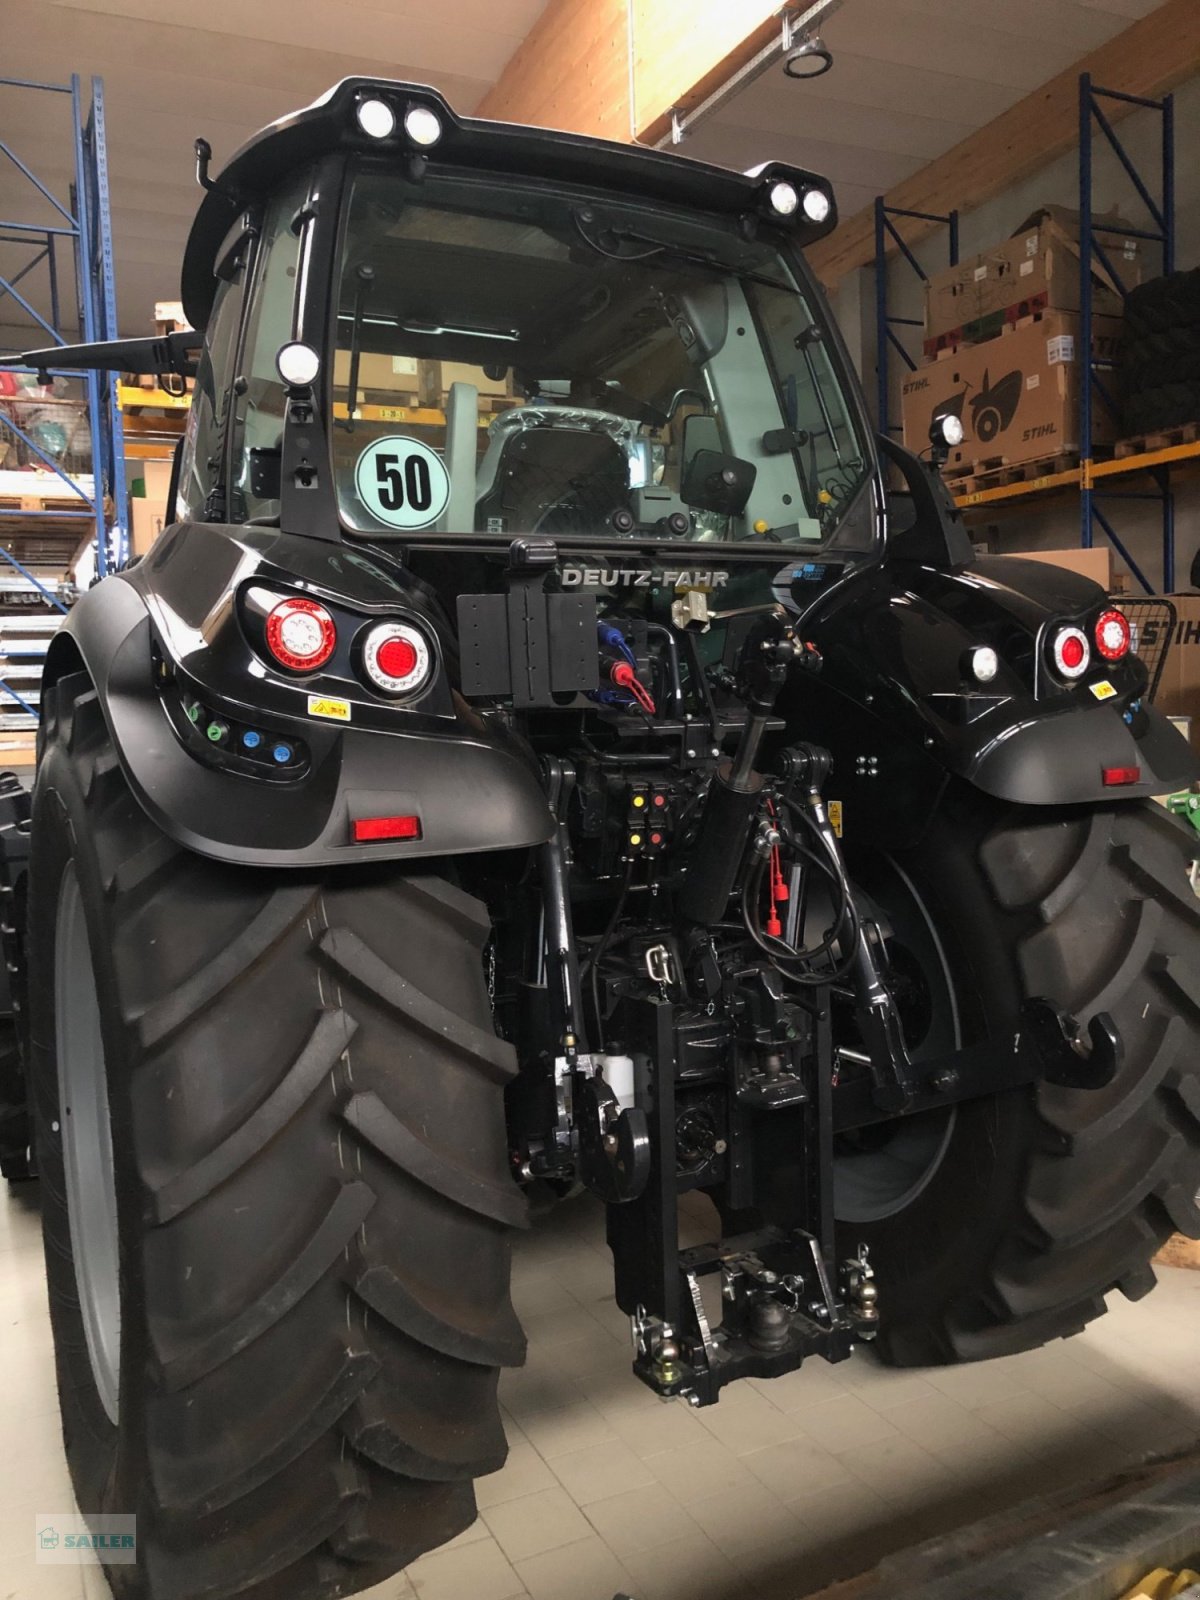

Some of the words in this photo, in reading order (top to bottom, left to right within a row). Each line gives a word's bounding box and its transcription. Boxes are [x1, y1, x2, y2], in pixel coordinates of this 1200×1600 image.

[902, 377, 931, 395] STIHL
[1022, 422, 1057, 442] STIHL
[375, 453, 432, 512] 50
[561, 568, 729, 588] DEUTZ-FAHR
[1140, 620, 1200, 645] SIH
